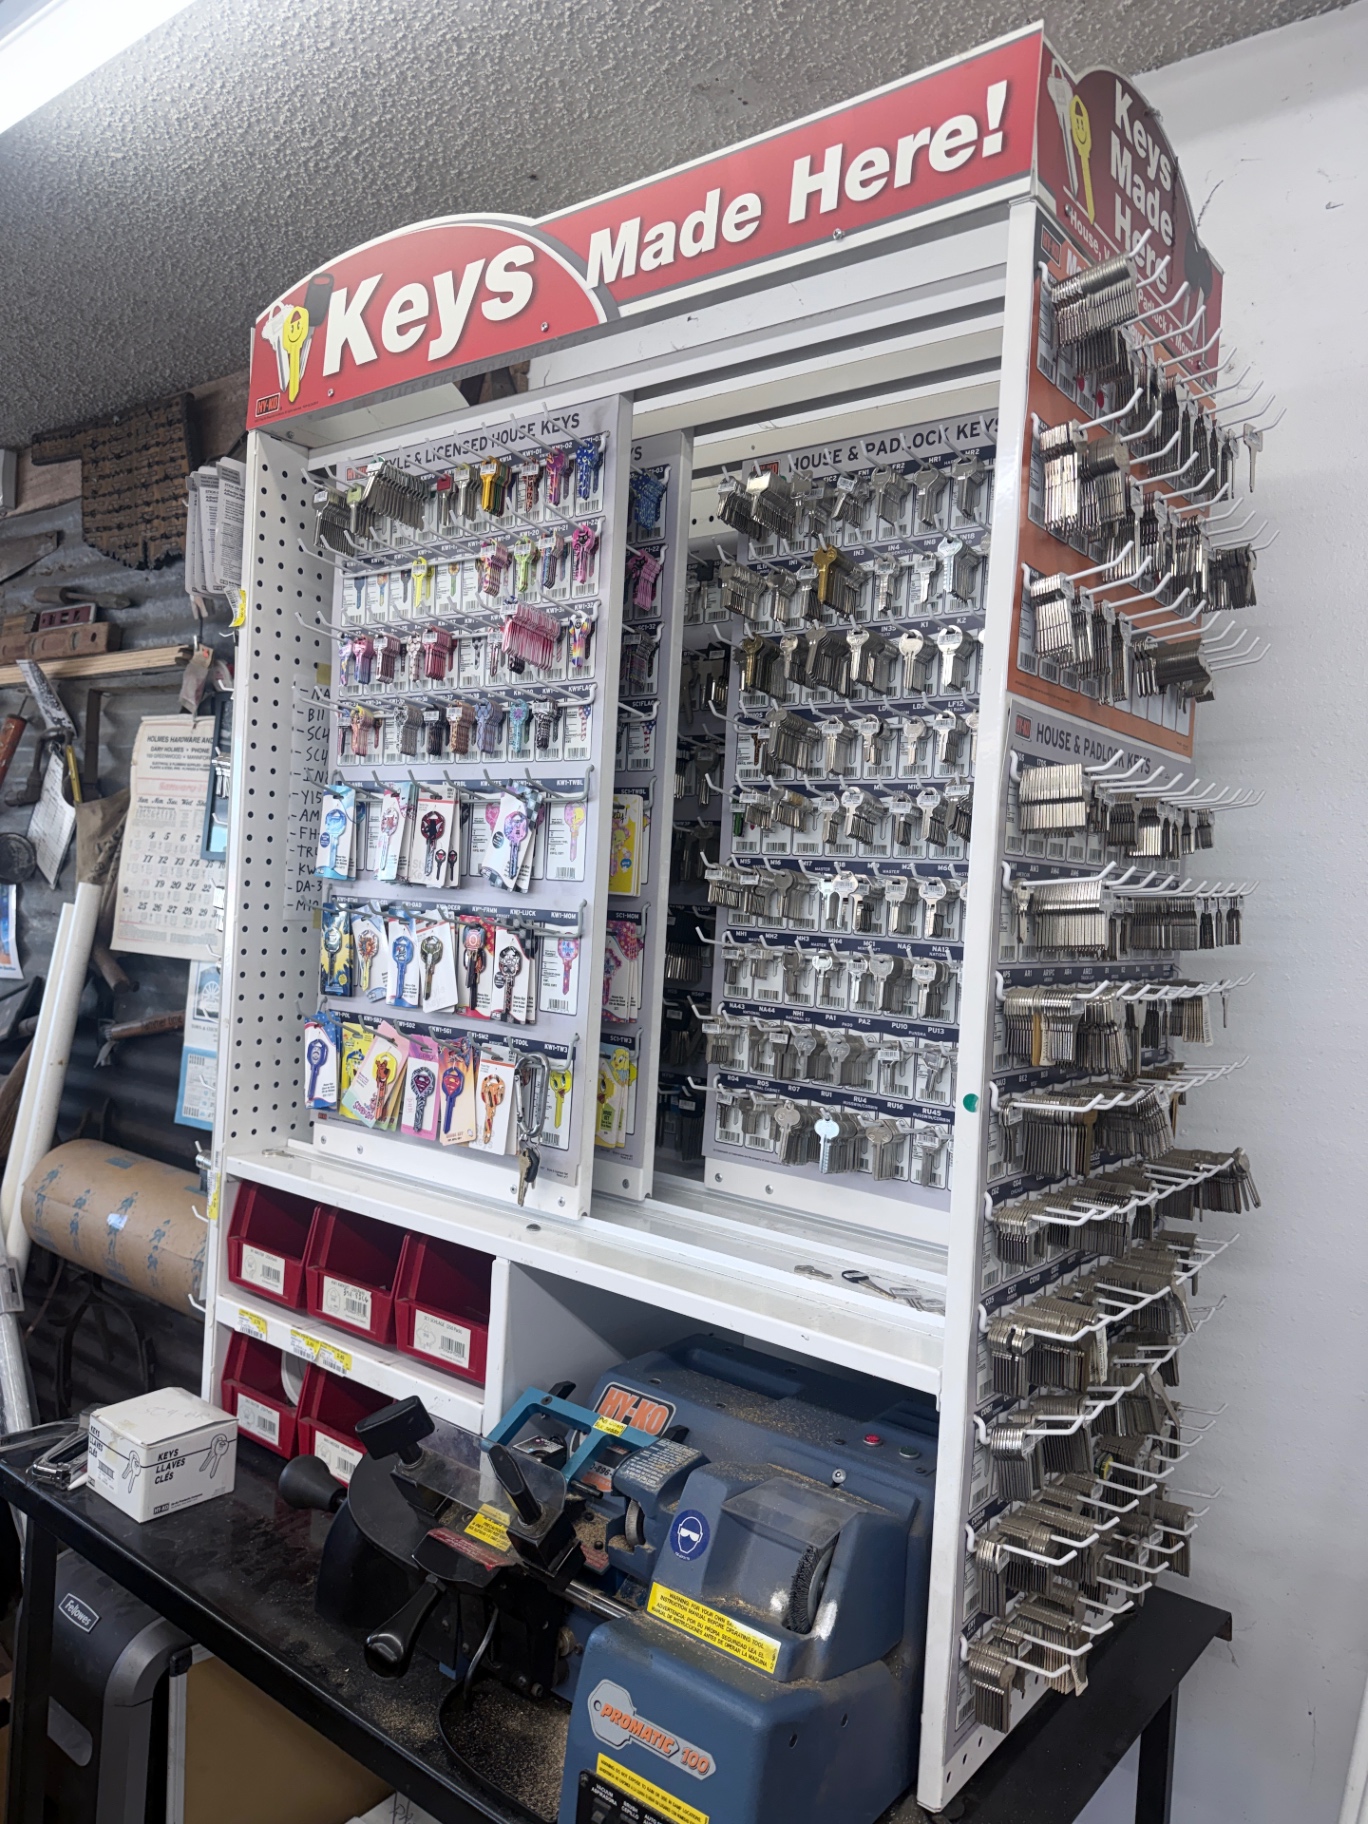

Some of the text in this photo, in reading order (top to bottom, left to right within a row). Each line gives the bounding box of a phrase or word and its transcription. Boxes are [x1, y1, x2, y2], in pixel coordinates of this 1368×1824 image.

[1115, 79, 1172, 192] Keys
[1110, 130, 1174, 247] Made
[323, 80, 1009, 377] Keys Made Here!
[1115, 192, 1169, 294] Here
[385, 412, 580, 470] TYLE & LICENSED HOUSE KEYS
[789, 449, 832, 473] HOUSE
[847, 447, 858, 461] &
[866, 429, 949, 457] PADLOCK
[957, 417, 997, 441] KEYS
[147, 735, 169, 743] HOLMES
[170, 736, 201, 744] HARDWARE
[1036, 722, 1071, 752] HOUSE
[1074, 734, 1080, 749] &
[1083, 737, 1125, 769] PADLOCK
[164, 832, 171, 840] 5
[180, 833, 187, 841] 6
[143, 854, 153, 863] 11
[158, 856, 168, 864] 12
[174, 857, 185, 866] 13
[189, 858, 200, 867] 14
[155, 880, 212, 892] 19 20 21 22
[138, 902, 208, 917] 25 26 27 28 29
[598, 1385, 670, 1435] HY-KO
[156, 1457, 186, 1473] LLAVES
[157, 1448, 179, 1461] KEYS
[154, 1471, 174, 1484] CLÉS
[64, 1599, 92, 1627] Fellowes
[660, 1594, 765, 1649] INSTRUCTION MANUAL BEFORE OPERATING TOOL
[701, 1608, 714, 1617] YOUR
[703, 1632, 717, 1643] ANTES
[724, 1642, 741, 1654] OPERAR
[704, 1625, 720, 1637] PROPIA
[721, 1633, 748, 1650] SEGURIDAD
[748, 1647, 757, 1656] LEA
[600, 1702, 710, 1775] PROMATIC 100
[596, 1783, 614, 1798] VACUUM
[621, 1805, 640, 1820] CEPILLO
[623, 1800, 639, 1813] BRUSH
